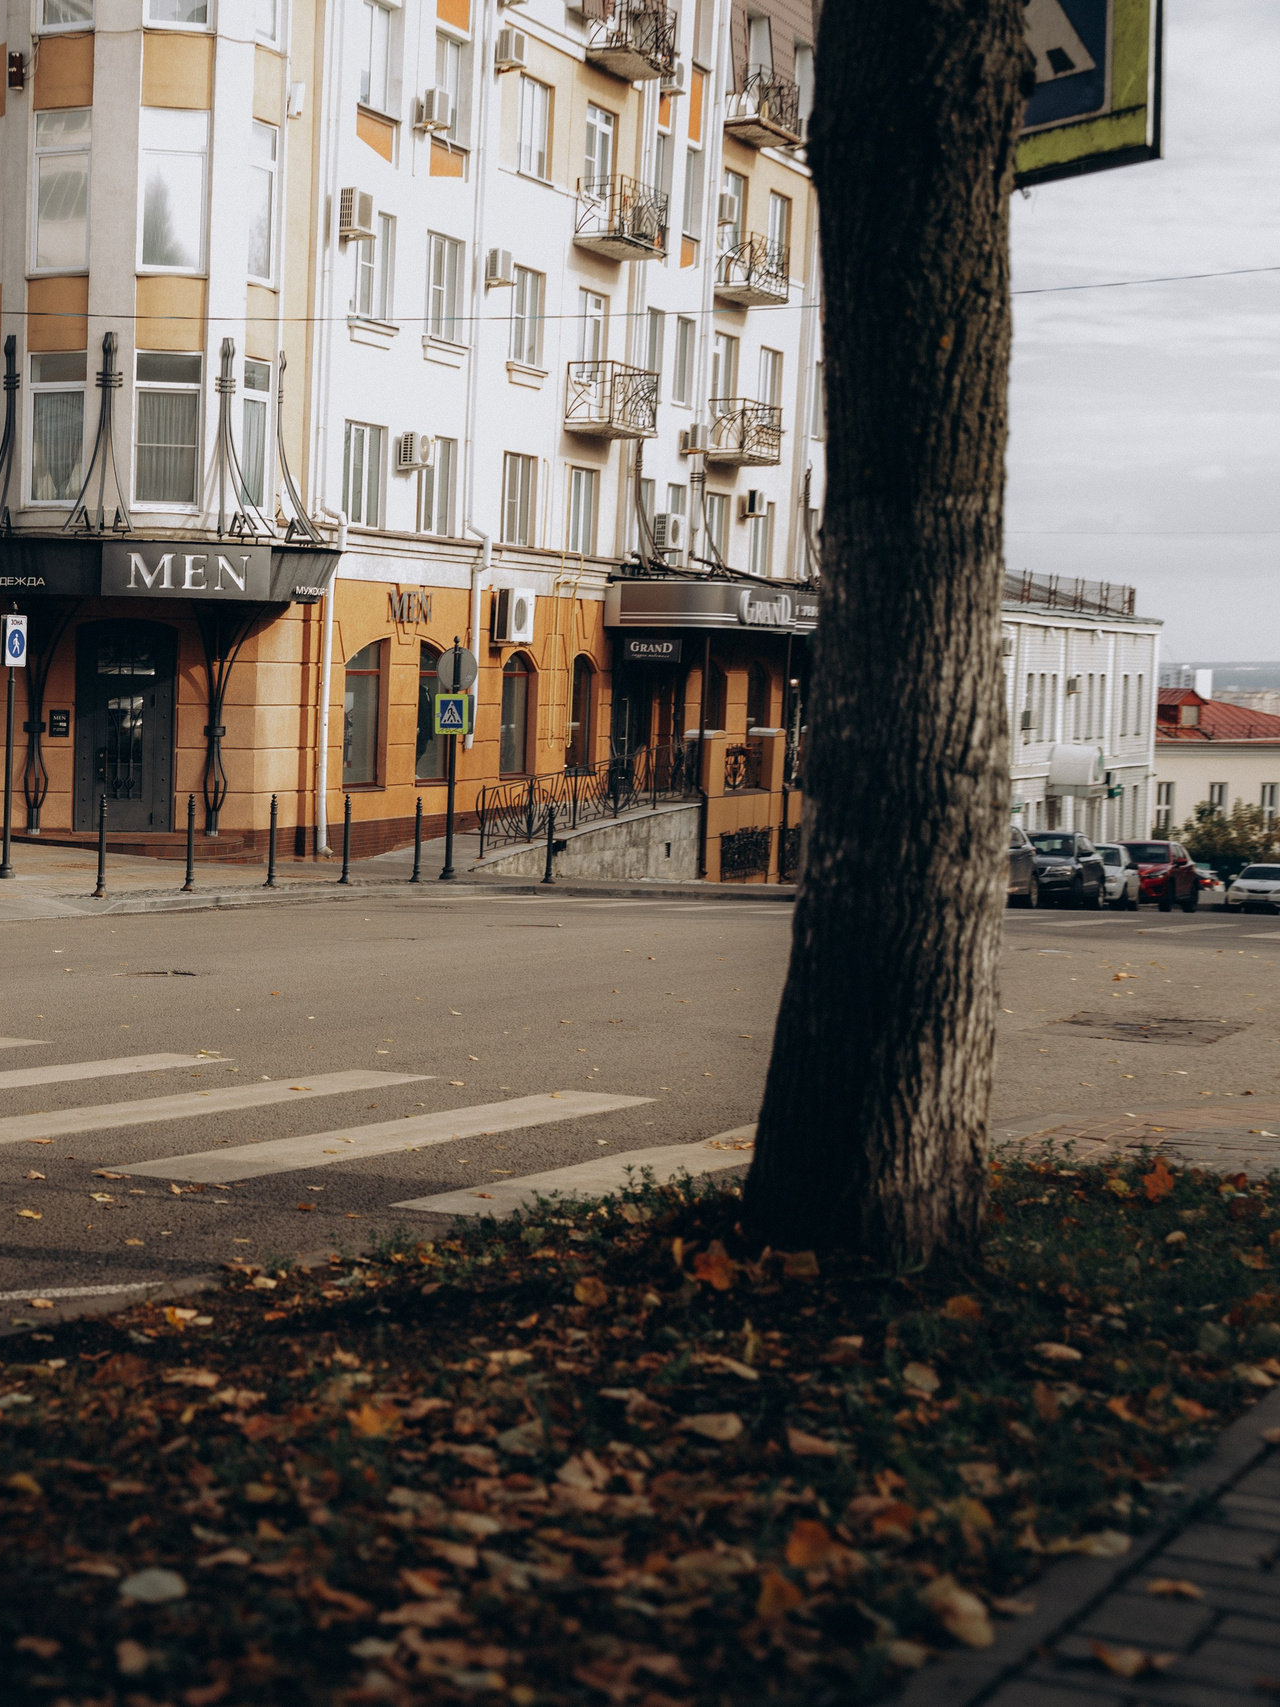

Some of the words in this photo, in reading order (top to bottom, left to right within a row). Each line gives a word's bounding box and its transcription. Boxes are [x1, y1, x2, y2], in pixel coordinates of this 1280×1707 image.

[126, 552, 251, 592] MEN
[389, 588, 433, 622] MEN
[10, 618, 23, 626] ЗОНА
[630, 641, 673, 653] GRAND
